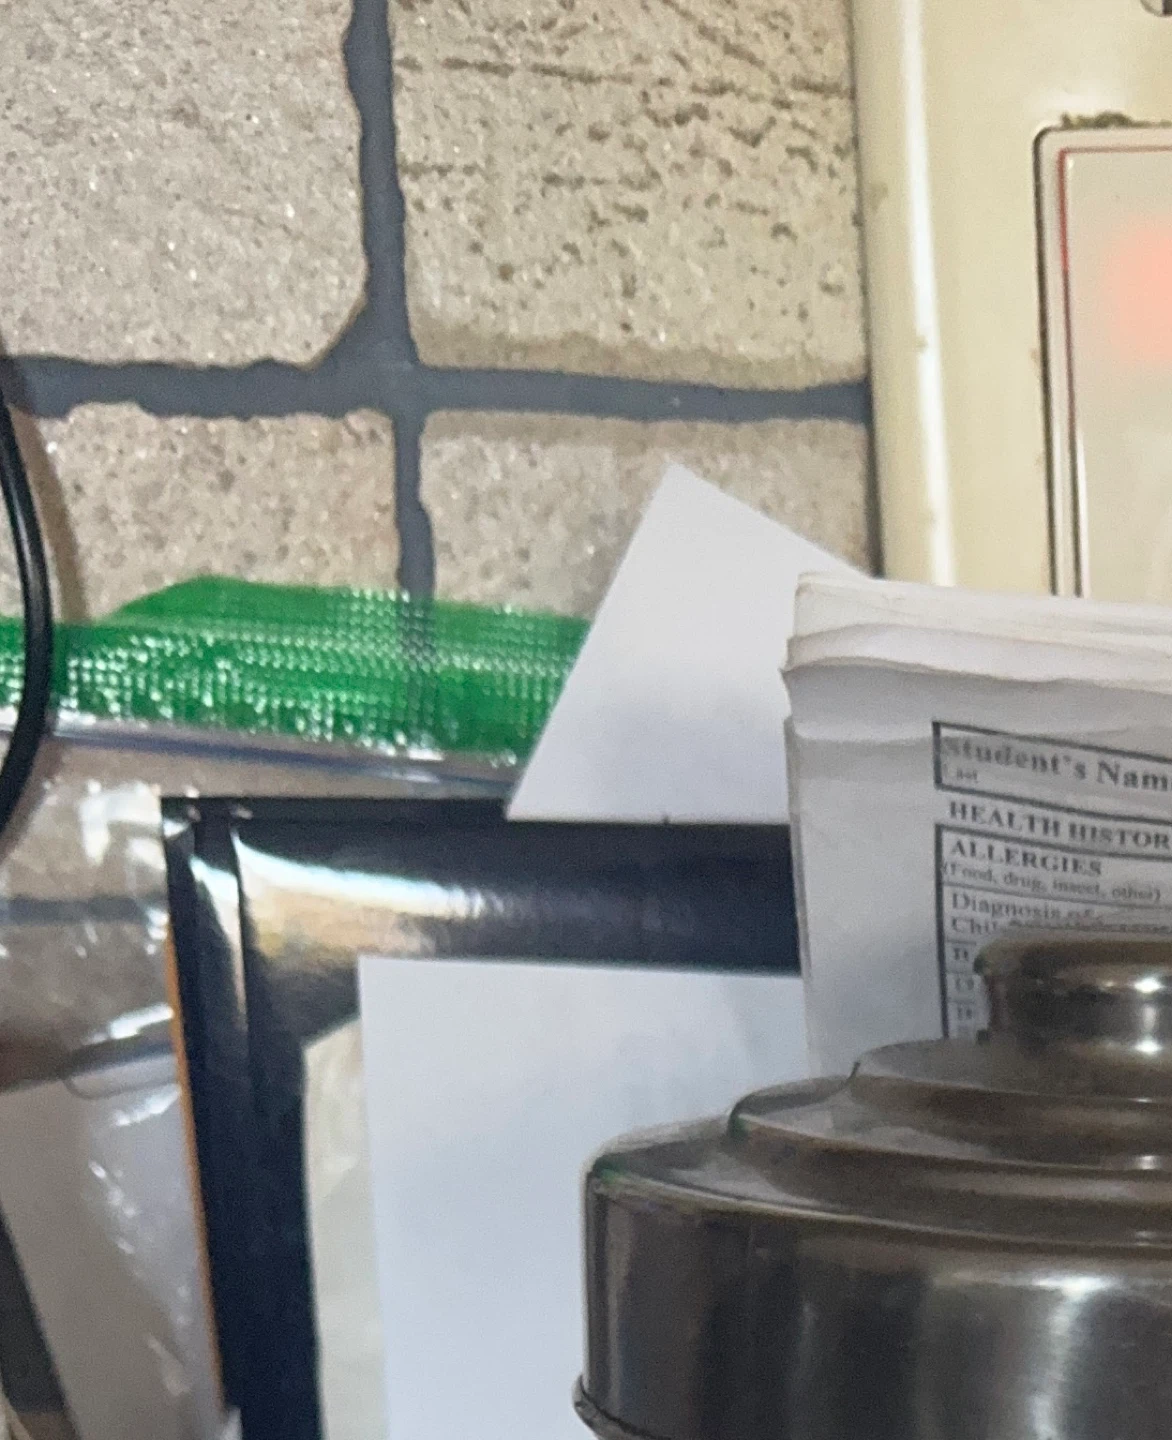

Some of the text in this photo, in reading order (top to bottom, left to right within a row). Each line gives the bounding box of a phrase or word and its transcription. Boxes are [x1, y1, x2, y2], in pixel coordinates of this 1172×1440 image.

[941, 735, 1087, 780] Student's
[950, 800, 1061, 840] HEALTH
[951, 839, 1102, 876] ALLERGIES
[952, 892, 1061, 921] Diagnosis
